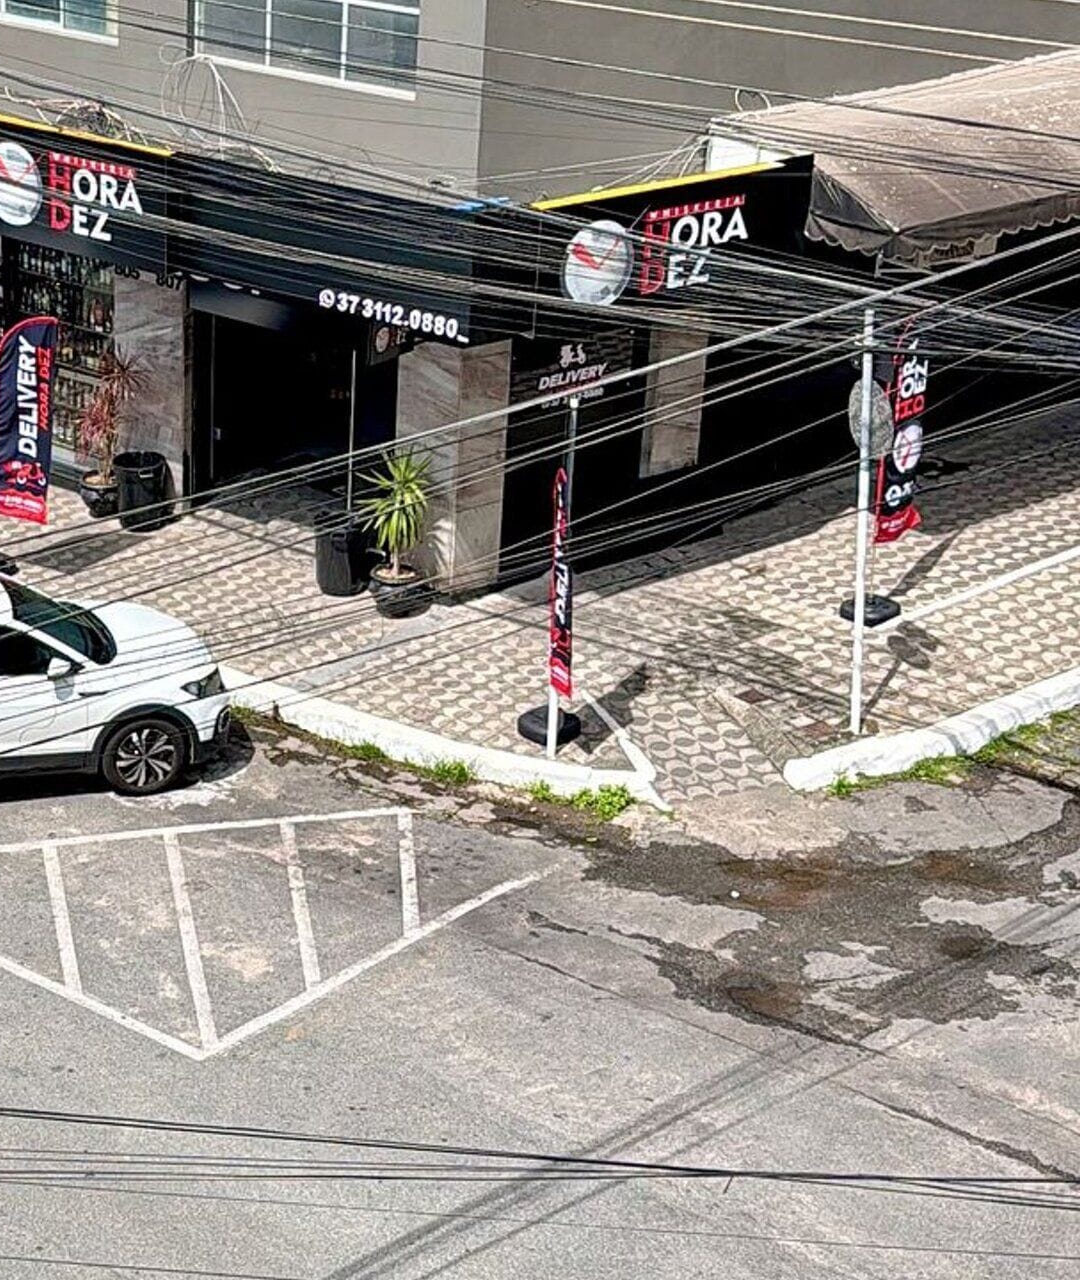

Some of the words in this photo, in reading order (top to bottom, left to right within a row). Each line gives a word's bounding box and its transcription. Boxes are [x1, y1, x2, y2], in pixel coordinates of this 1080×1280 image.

[48, 163, 143, 215] HORA
[50, 198, 112, 242] DEZ
[642, 206, 749, 258] HORA
[336, 292, 360, 314] 37
[361, 298, 459, 338] 3112.0880
[38, 346, 52, 379] DEZ
[538, 361, 608, 391] DELIVERY
[17, 335, 38, 458] DELIVERY
[38, 384, 51, 431] HORA
